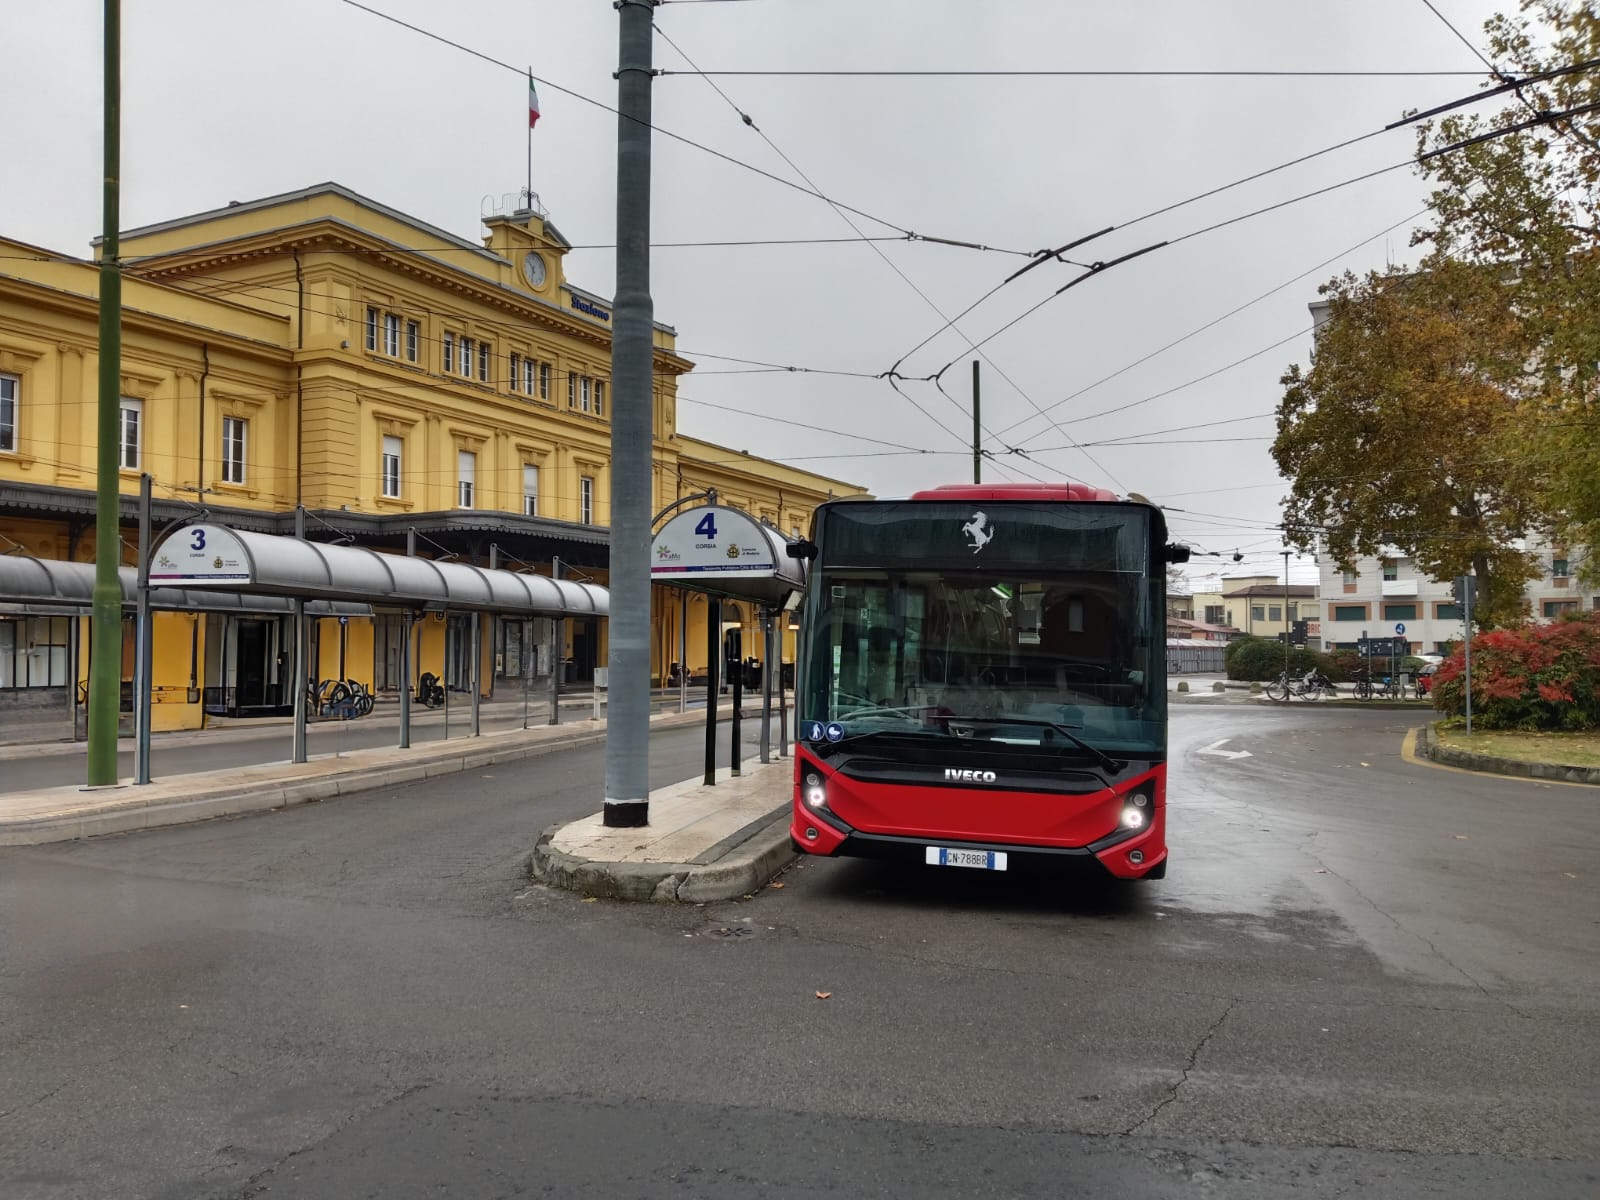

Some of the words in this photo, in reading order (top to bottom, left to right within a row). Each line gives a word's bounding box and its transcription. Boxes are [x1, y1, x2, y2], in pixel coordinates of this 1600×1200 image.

[695, 513, 717, 539] 4
[191, 529, 206, 550] 3
[945, 769, 996, 782] IVECO
